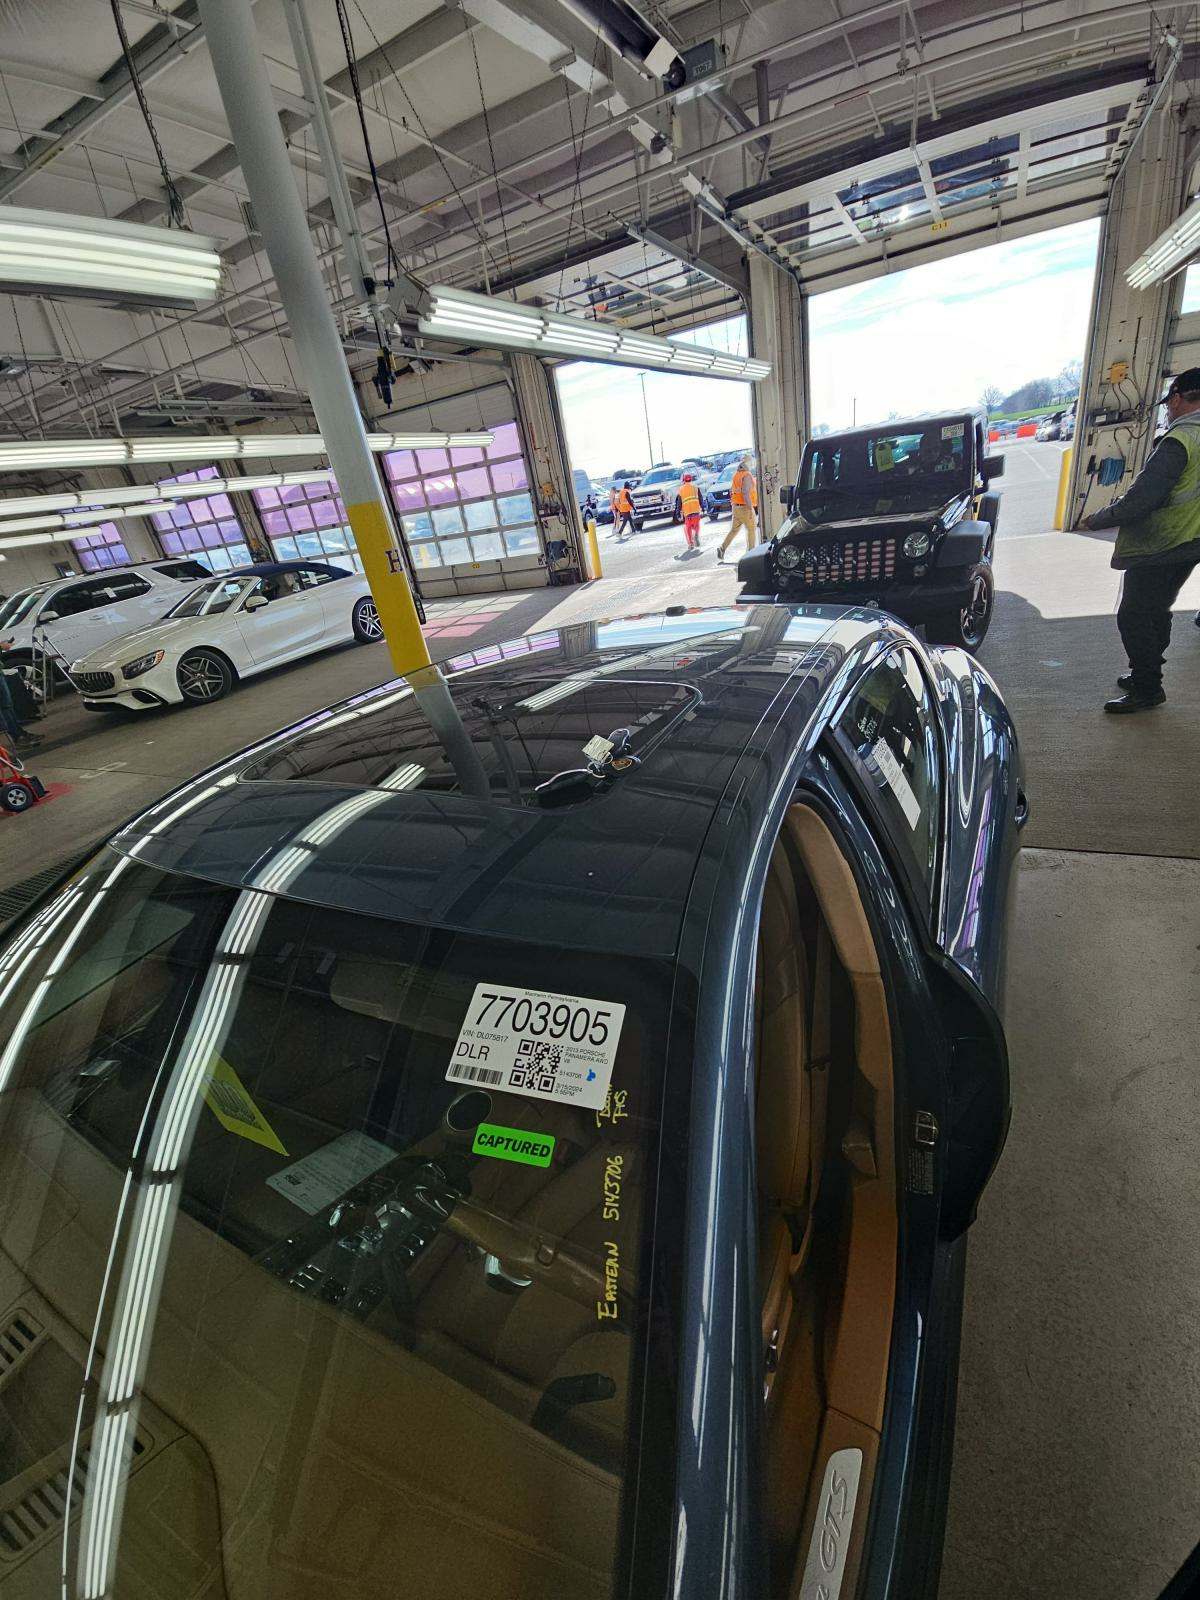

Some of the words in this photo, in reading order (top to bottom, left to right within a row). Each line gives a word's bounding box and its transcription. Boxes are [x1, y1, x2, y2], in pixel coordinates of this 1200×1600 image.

[384, 549, 403, 573] H
[475, 993, 611, 1046] 7703905
[456, 1042, 490, 1061] DLR
[477, 1132, 551, 1157] CAPTURED
[603, 1155, 624, 1222] 5143706
[819, 1470, 848, 1573] GTS
